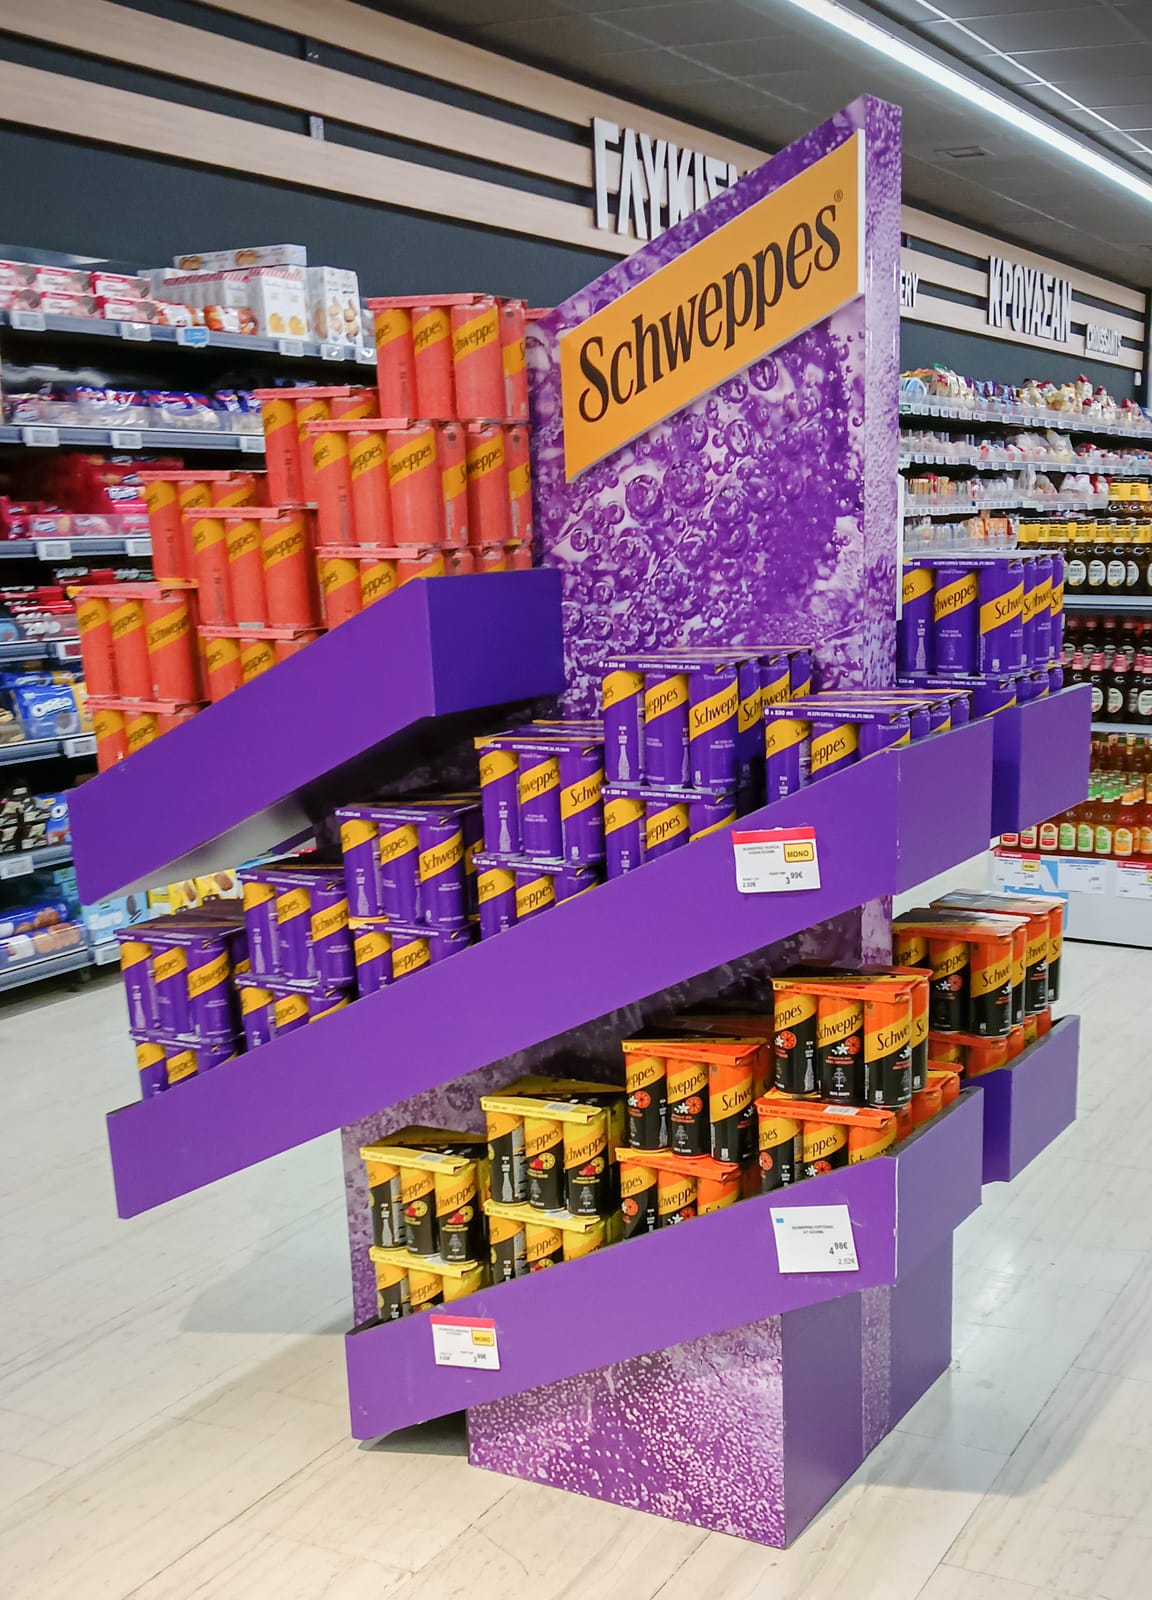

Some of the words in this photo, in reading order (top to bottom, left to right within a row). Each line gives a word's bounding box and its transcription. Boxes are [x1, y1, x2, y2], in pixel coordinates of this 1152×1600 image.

[593, 116, 751, 241] ΓΛΥΚΙ
[900, 269, 919, 307] ERY
[989, 256, 1072, 342] ΚΡΟΥΑΣΑΝ
[579, 205, 841, 423] Schweppes
[352, 444, 382, 470] eppes
[363, 572, 391, 596] eppes
[936, 583, 977, 613] hweppes
[648, 687, 678, 710] eppes
[694, 692, 738, 727] Schwepp
[812, 737, 846, 765] eppes
[650, 815, 680, 839] eppes
[423, 844, 463, 873] Schwepp
[519, 885, 552, 907] eppes
[818, 1013, 861, 1039] chweppe
[877, 1025, 910, 1051] Schwe
[671, 1071, 706, 1096] weppes
[722, 1088, 752, 1111] Schwe
[806, 1134, 837, 1159] eppes
